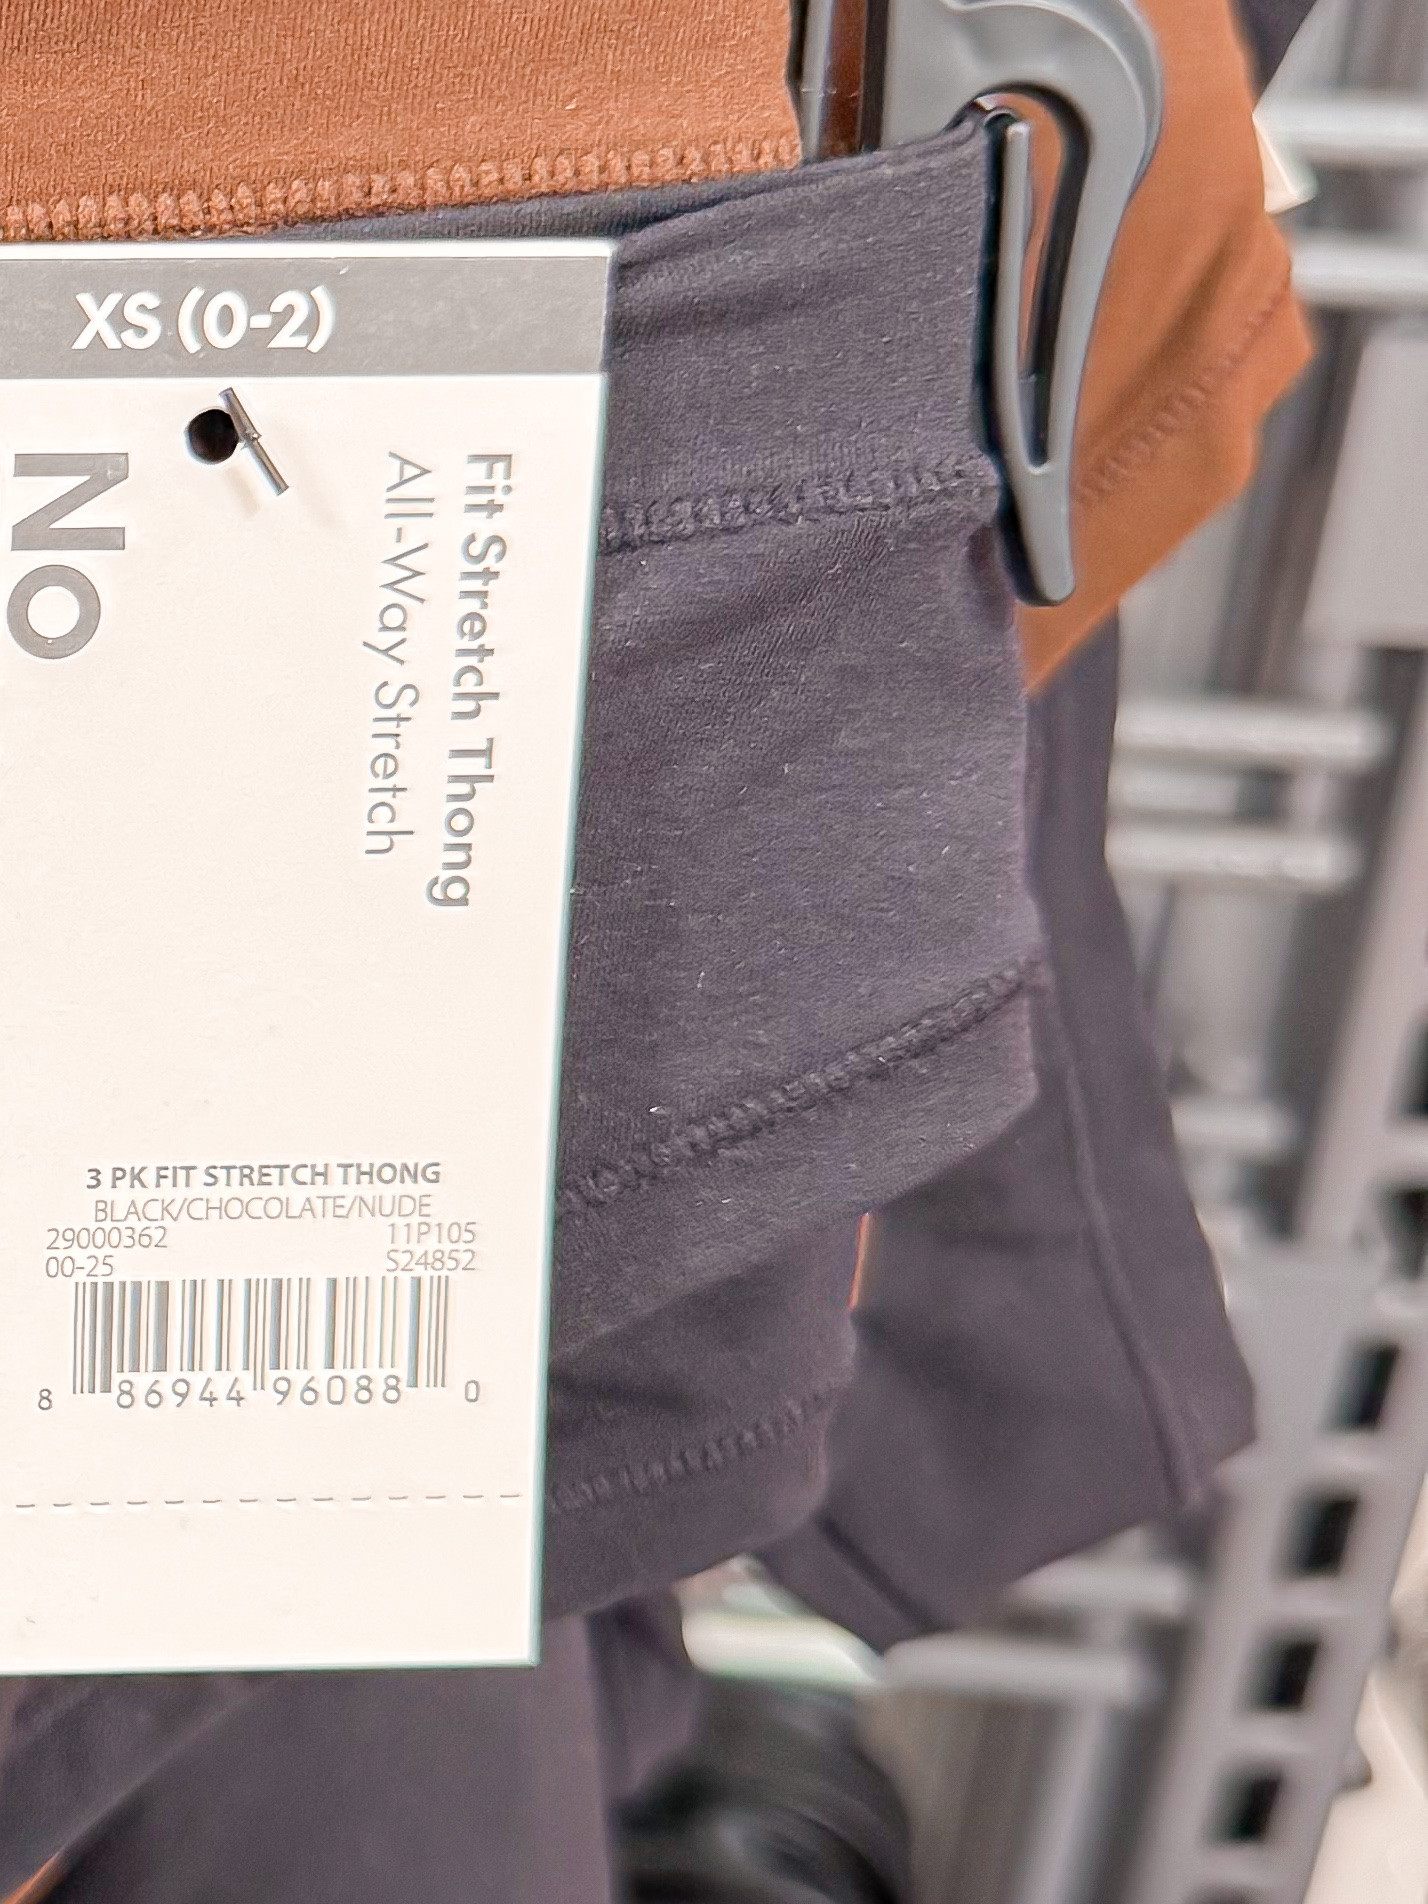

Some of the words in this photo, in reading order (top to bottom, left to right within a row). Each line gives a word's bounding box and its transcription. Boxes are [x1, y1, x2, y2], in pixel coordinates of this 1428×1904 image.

[72, 291, 162, 350] XS
[176, 285, 334, 353] (0-2)
[465, 452, 514, 520] Fit
[7, 452, 129, 660] NO
[362, 451, 433, 667] All-Way
[450, 533, 508, 723] Stretch
[364, 680, 421, 857] Stretch
[426, 738, 495, 908] Thong
[85, 1167, 102, 1190] 3
[111, 1165, 149, 1189] PK
[155, 1163, 198, 1188] FIT
[203, 1162, 330, 1187] STRETCH
[338, 1161, 442, 1186] THONG
[93, 1193, 433, 1223] BLACK/CHOCOLATE/NUDE
[387, 1221, 478, 1245] 11P105
[45, 1225, 169, 1250] 29000362
[385, 1248, 477, 1273] S24852
[45, 1254, 115, 1278] 00-25
[37, 1387, 53, 1411] 8
[115, 1376, 246, 1409] 86944
[272, 1373, 402, 1406] 96088
[463, 1379, 481, 1404] 0
